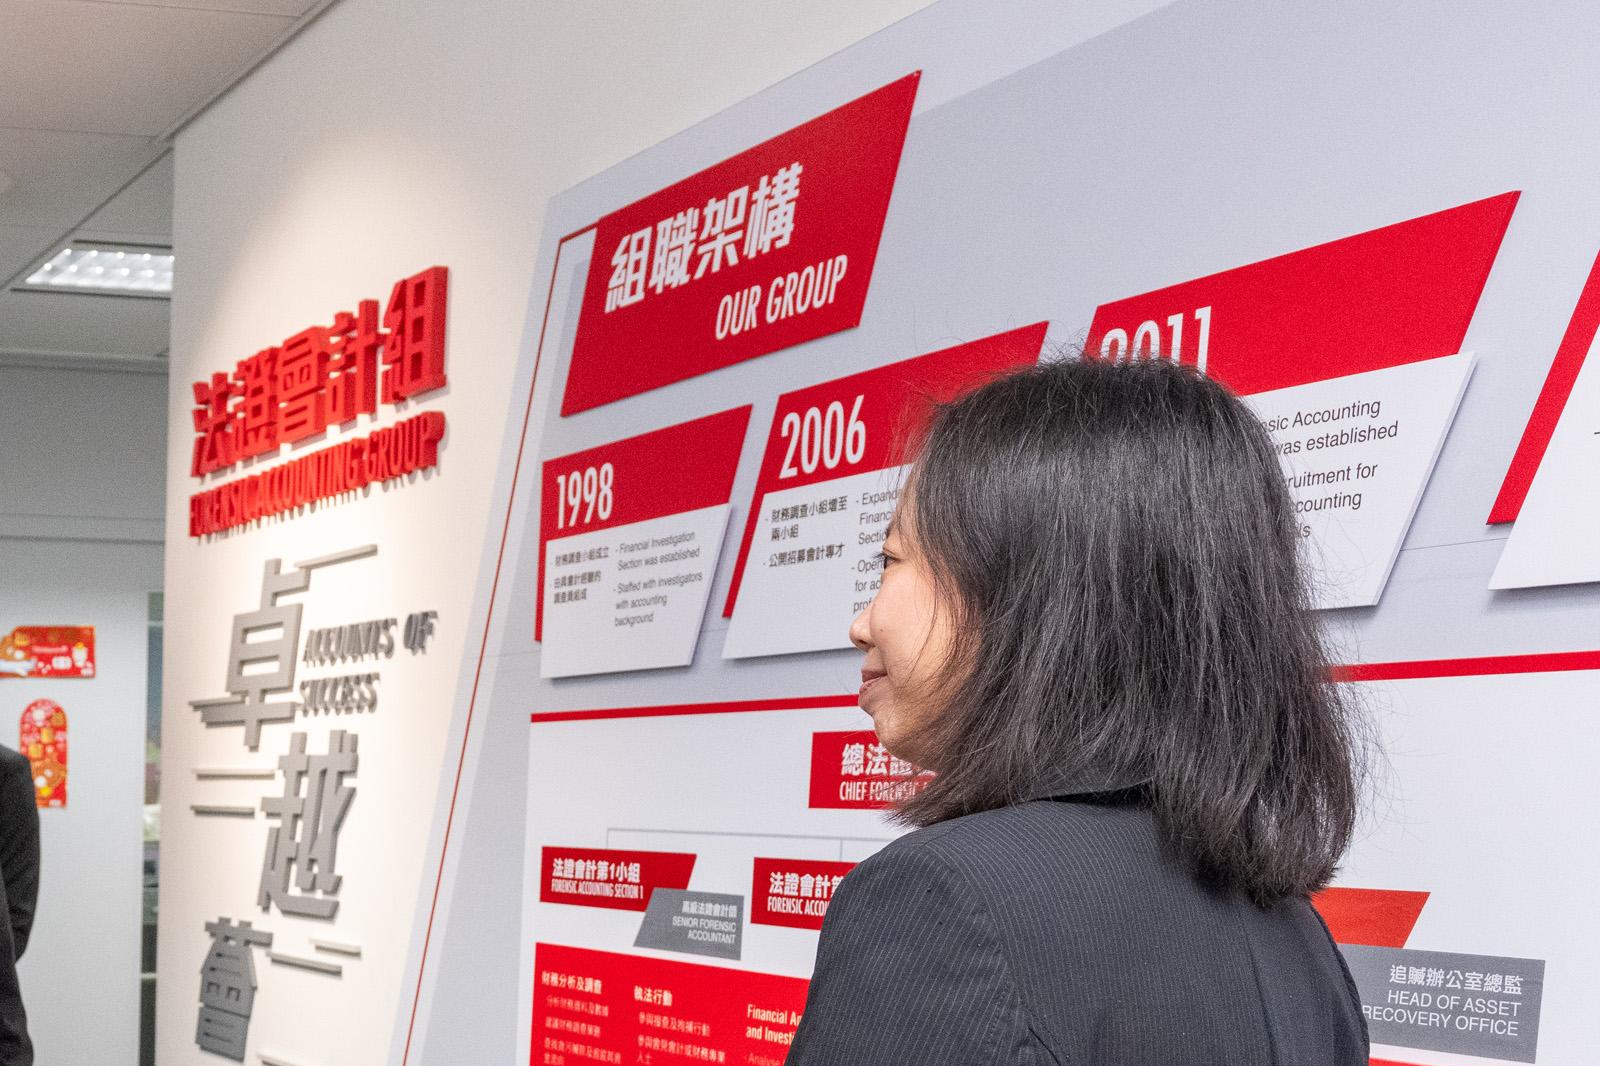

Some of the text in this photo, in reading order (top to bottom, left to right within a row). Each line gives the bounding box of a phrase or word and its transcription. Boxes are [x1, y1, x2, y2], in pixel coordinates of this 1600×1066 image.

[604, 161, 803, 314] 組職架構
[715, 255, 849, 340] OUR GROUP
[191, 266, 447, 478] 法證會計組
[1292, 401, 1381, 428] Accounting
[779, 394, 866, 480] 2006
[1306, 420, 1398, 451] established
[364, 410, 446, 484] GROUP
[1285, 463, 1378, 488] ruitment for
[557, 462, 613, 529] 1998
[1296, 492, 1362, 513] counting
[860, 510, 892, 525] Financ
[771, 524, 799, 541] 兩小組
[619, 538, 649, 554] Financial
[617, 547, 700, 571] Section was established
[643, 578, 657, 590] with
[855, 580, 867, 592] for
[616, 594, 667, 610] with accounting
[615, 614, 654, 627] background
[403, 610, 438, 656] OF
[840, 781, 867, 801] CHIEF
[551, 878, 577, 894] FORENSIC
[578, 880, 614, 897] ACCOUNTING
[614, 883, 639, 899] SECTION
[767, 896, 803, 915] FORENSIC
[672, 915, 736, 933] SENIOR FORENSIC
[688, 930, 736, 944] ACCOUNTANT
[1389, 964, 1524, 995] 追贓辦公室總監
[634, 985, 673, 1007] 執法行動
[1387, 990, 1522, 1017] HEAD OF ASSET
[747, 1004, 788, 1024] Financial
[1362, 1005, 1519, 1036] RECOVERY OFFICE
[746, 1025, 762, 1040] and
